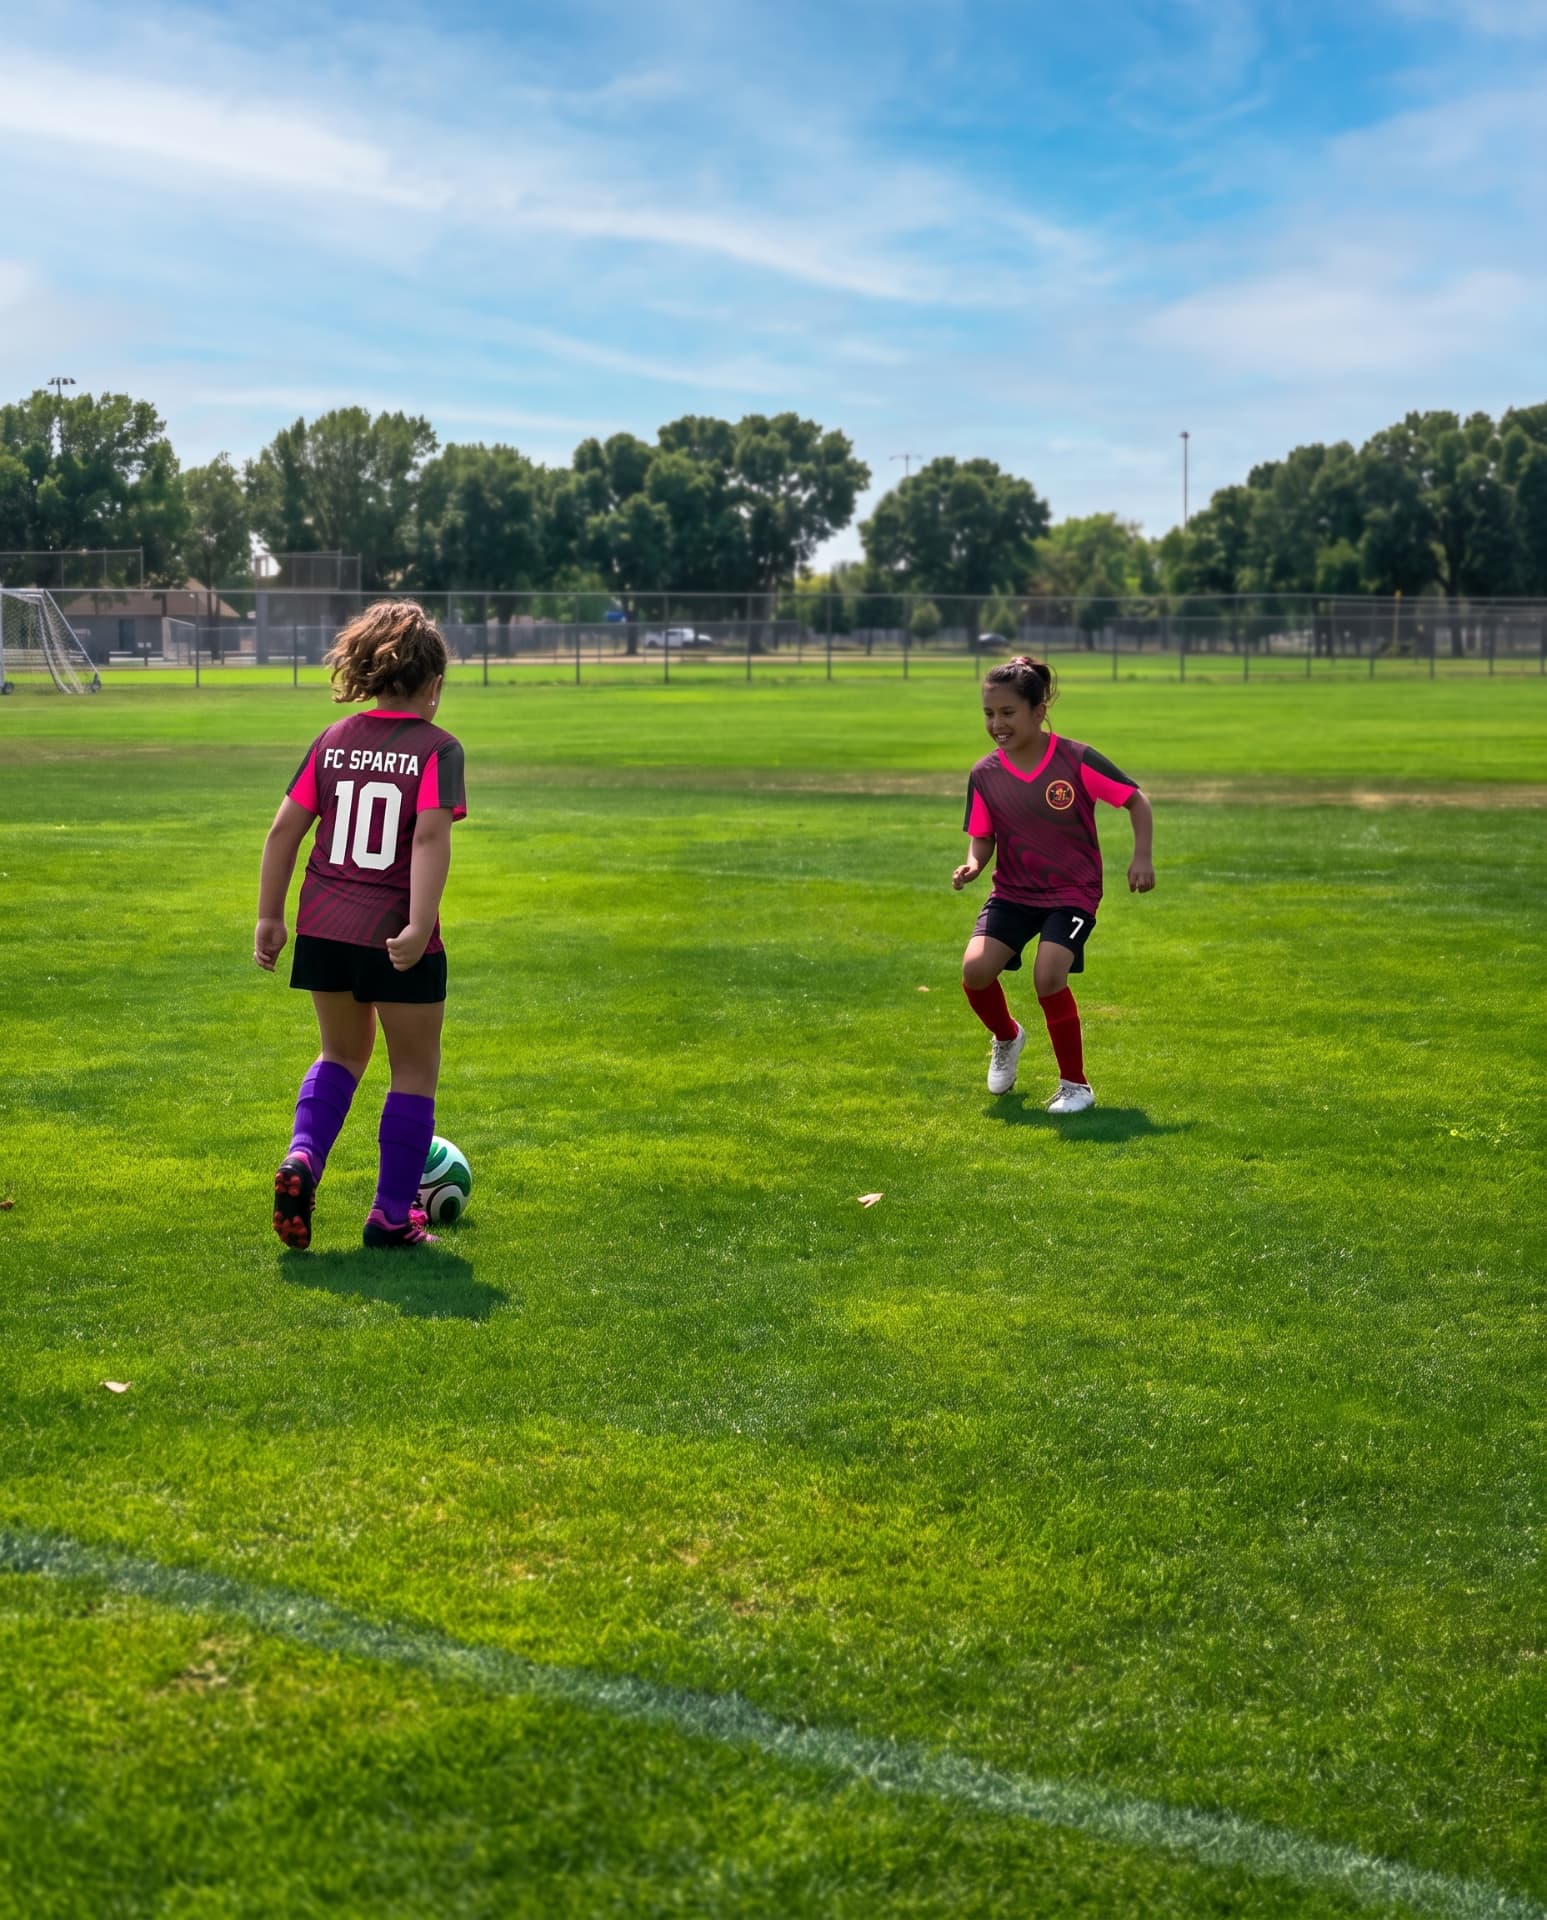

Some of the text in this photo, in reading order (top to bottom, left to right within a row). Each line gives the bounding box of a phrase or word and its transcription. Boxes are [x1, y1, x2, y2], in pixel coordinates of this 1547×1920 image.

[323, 748, 419, 776] FC SPARTA
[329, 780, 402, 871] 10
[1069, 915, 1084, 939] 7
